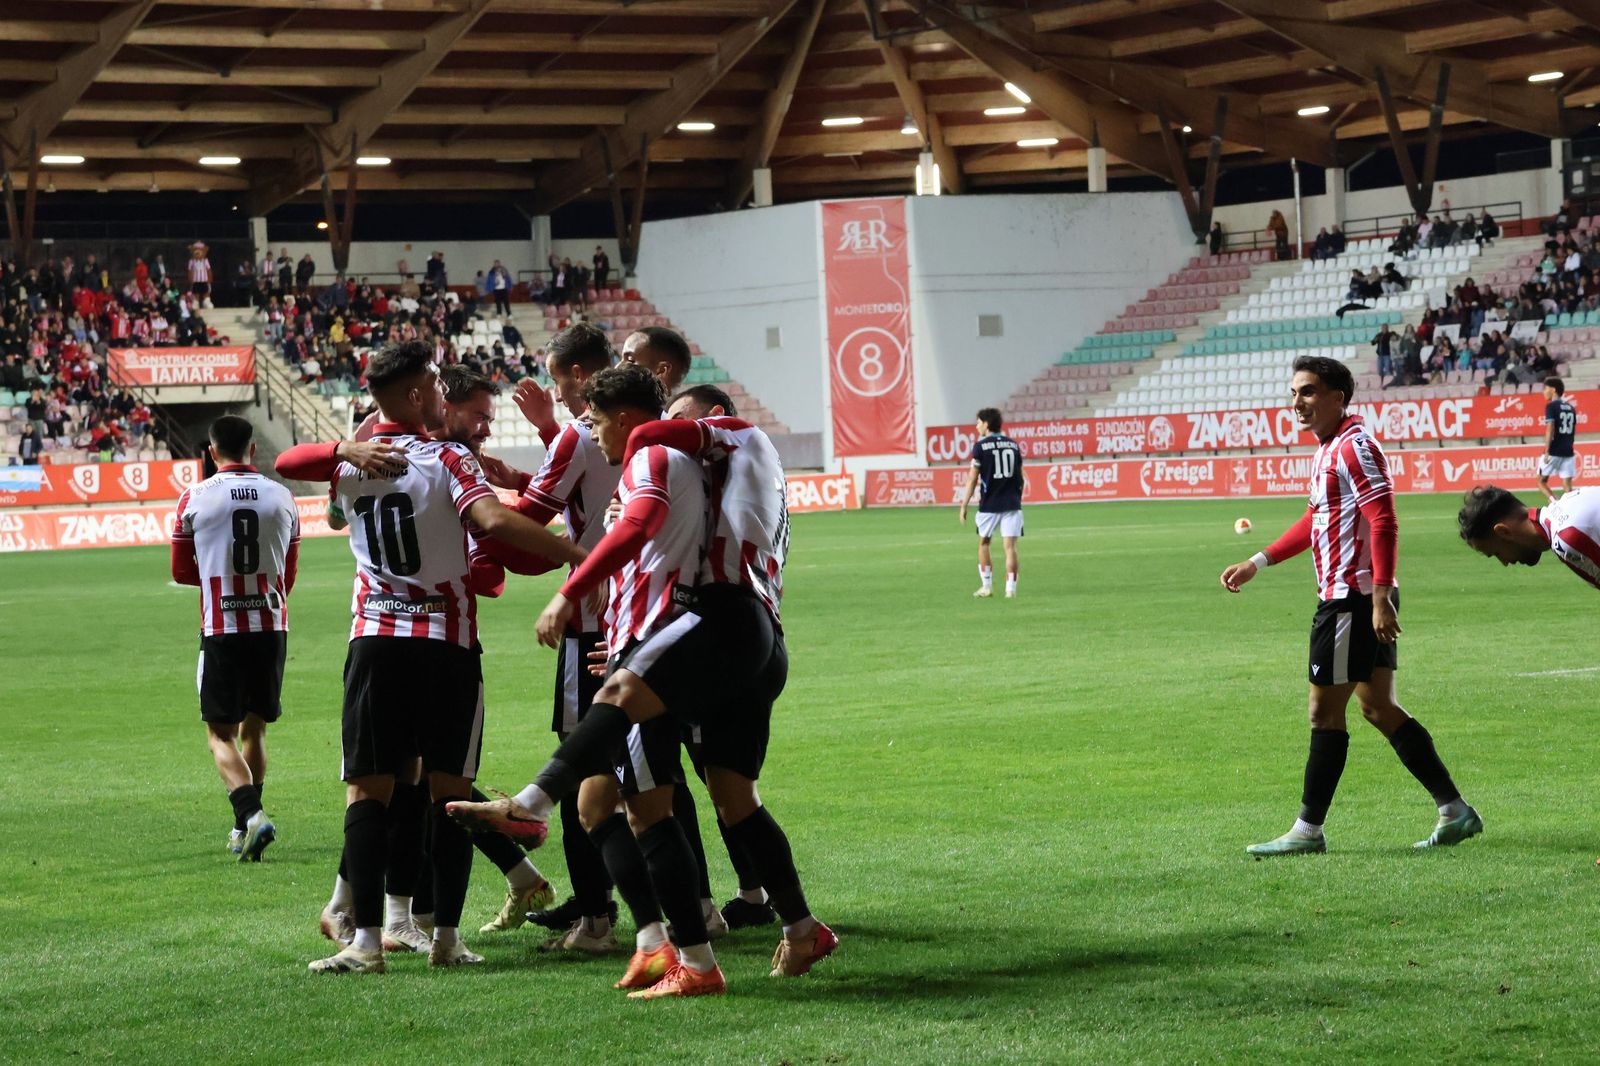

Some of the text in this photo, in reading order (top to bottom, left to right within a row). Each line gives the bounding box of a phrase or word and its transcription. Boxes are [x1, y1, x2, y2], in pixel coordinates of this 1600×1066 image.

[858, 343, 883, 380] 8
[1187, 409, 1273, 449] ZAMORA
[1485, 415, 1534, 431] sangregorio
[1559, 411, 1575, 434] 33
[928, 427, 977, 460] cubi
[993, 449, 1015, 479] 10
[1060, 463, 1119, 488] Freigel
[1153, 460, 1215, 485] Freigel
[1256, 459, 1278, 480] E.S.
[230, 488, 259, 501] RUFO
[1267, 480, 1305, 492] Morales
[58, 512, 164, 546] ZAMORA
[232, 508, 260, 575] 8
[353, 492, 421, 576] 10
